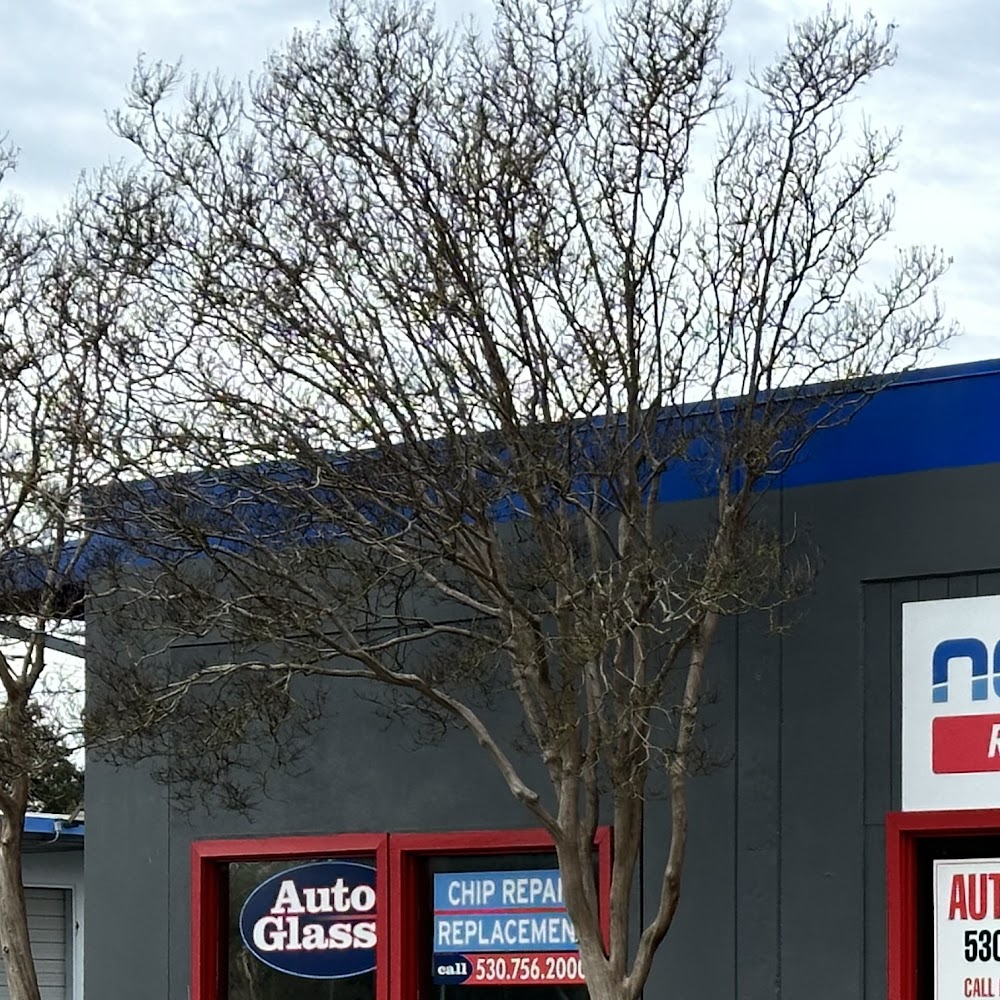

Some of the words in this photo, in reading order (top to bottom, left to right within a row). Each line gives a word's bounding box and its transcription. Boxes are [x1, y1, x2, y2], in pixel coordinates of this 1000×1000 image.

[270, 878, 376, 915] Auto
[448, 879, 496, 907] CHIP
[502, 877, 562, 905] REPAI
[253, 915, 377, 953] Glass
[438, 917, 578, 946] REPLACEMEN
[438, 960, 467, 977] call
[964, 977, 995, 998] CALL
